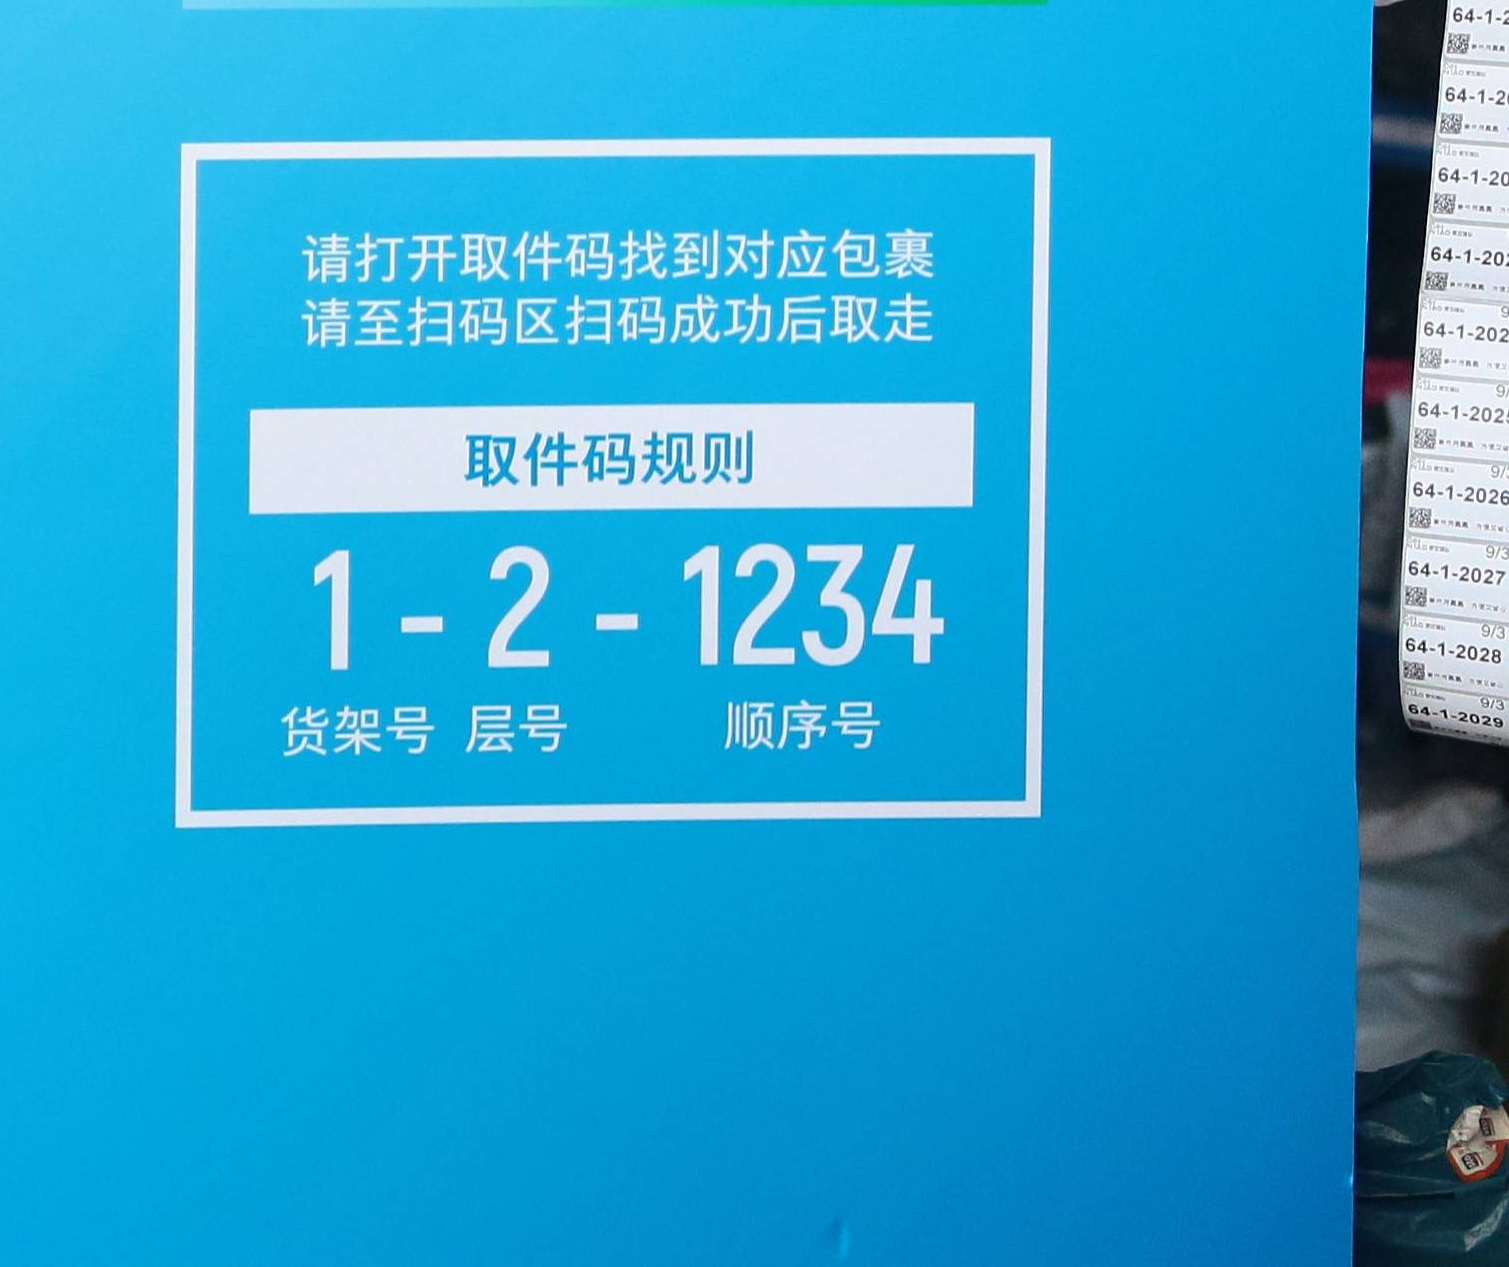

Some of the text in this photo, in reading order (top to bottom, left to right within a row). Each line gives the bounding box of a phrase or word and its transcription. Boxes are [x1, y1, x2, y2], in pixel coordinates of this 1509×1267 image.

[1445, 87, 1509, 105] 64-1-2
[301, 228, 934, 284] 请打开取件码找到对应包裹
[301, 292, 933, 348] 请至扫码区扫码成功后取走
[1424, 321, 1509, 343] 64-1-202
[464, 430, 753, 488] 取件码规则
[1413, 481, 1509, 505] 64-1-2026
[1408, 561, 1506, 585] 64-1-2027
[313, 549, 350, 671] 1
[488, 545, 550, 668] 2
[683, 543, 945, 667] 1234
[1481, 624, 1505, 639] 9/3
[1405, 638, 1502, 664] 64-1-2028
[1408, 704, 1504, 728] 64-1-2029
[1480, 697, 1505, 711] 9/3
[281, 699, 881, 757] 货架号 层号 顺序号
